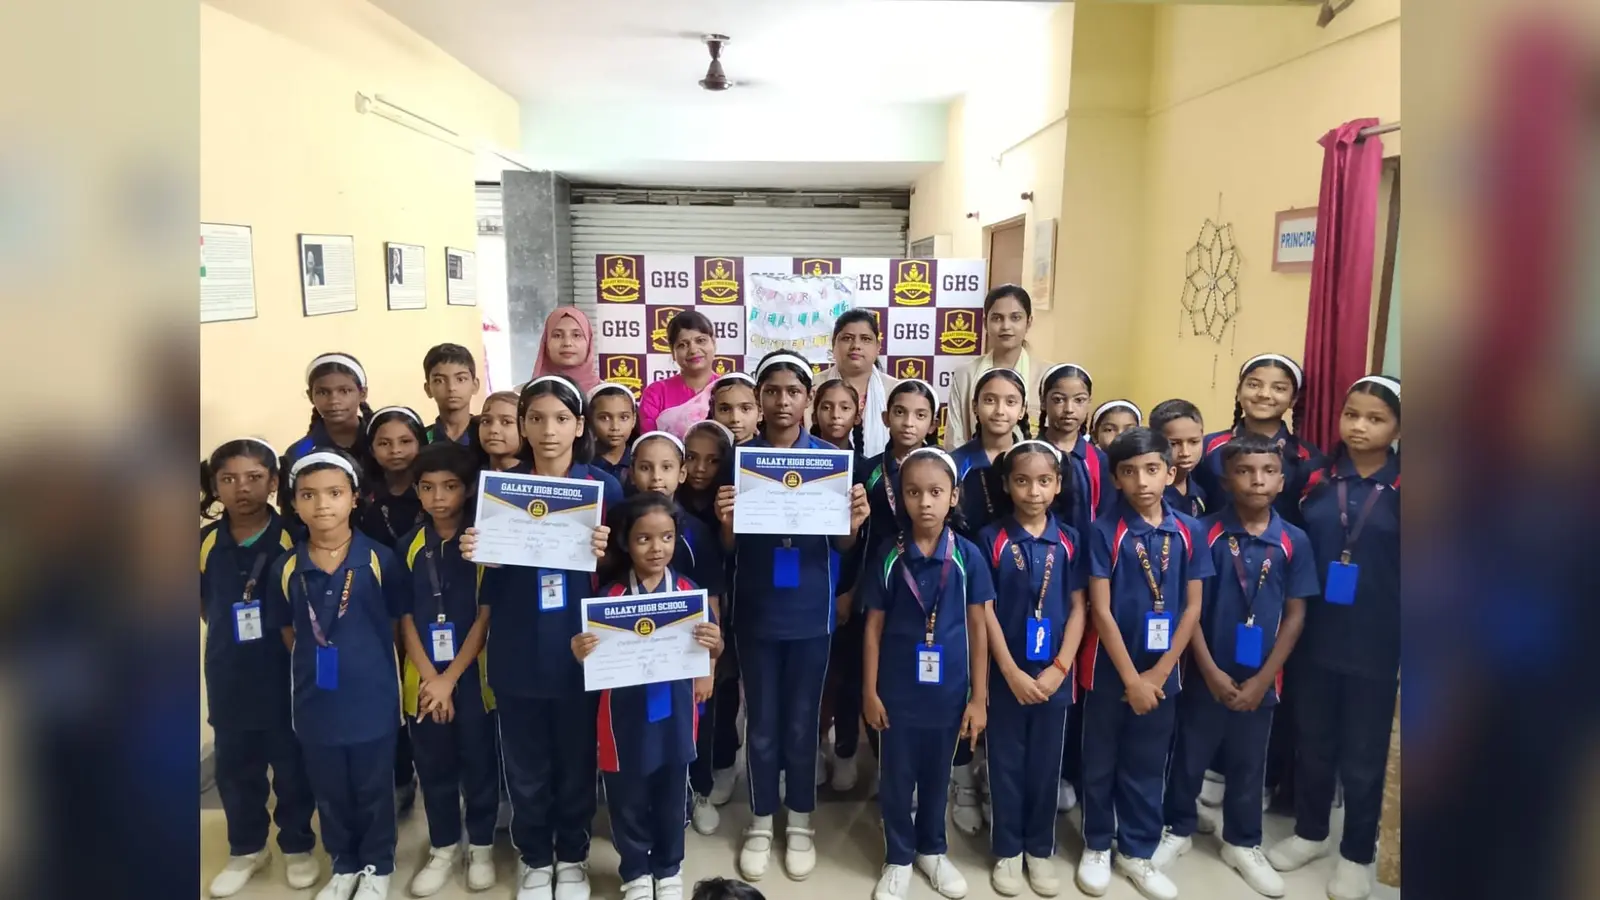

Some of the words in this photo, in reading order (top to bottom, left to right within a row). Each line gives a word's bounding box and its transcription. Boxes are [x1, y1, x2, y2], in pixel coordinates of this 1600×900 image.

[1281, 231, 1316, 248] PRINCIPA
[651, 271, 688, 288] GHS
[856, 274, 883, 290] HS
[943, 275, 979, 291] GHS
[603, 320, 640, 337] GHS
[714, 322, 738, 338] HS
[894, 323, 930, 340] GHS
[756, 457, 786, 465] GALAXY
[787, 458, 804, 466] HIGH
[805, 459, 834, 467] SCHOOL
[501, 482, 532, 493] GALAXY
[533, 486, 552, 495] HIGH
[553, 487, 583, 498] SCHOOL
[604, 605, 637, 616] GALAXY
[638, 603, 656, 613] HIGH
[657, 601, 688, 611] SCHOOL
